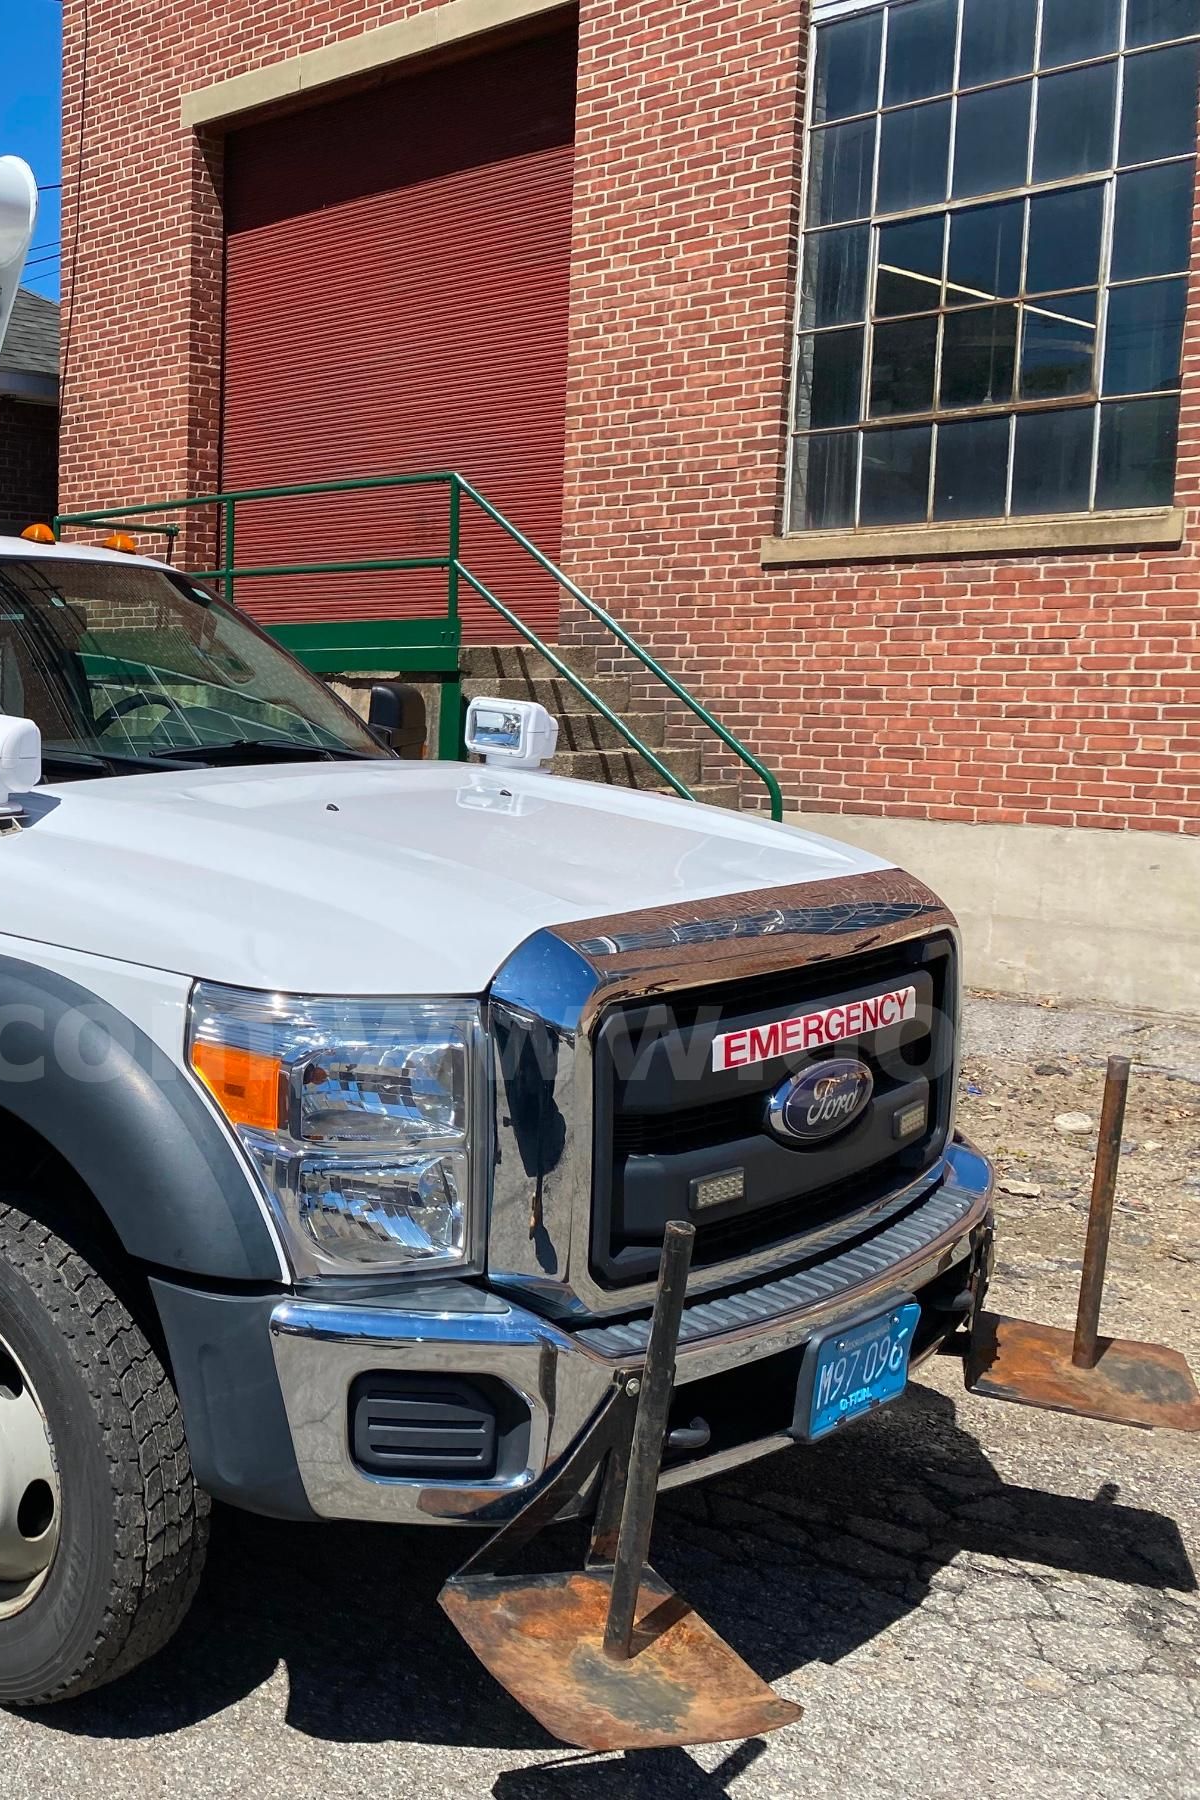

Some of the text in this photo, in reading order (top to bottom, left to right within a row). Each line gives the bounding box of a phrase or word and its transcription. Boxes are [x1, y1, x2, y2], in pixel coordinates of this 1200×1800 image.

[723, 989, 909, 1069] EMERGENCY
[806, 1076, 860, 1126] Ford
[816, 1349, 861, 1410] M97
